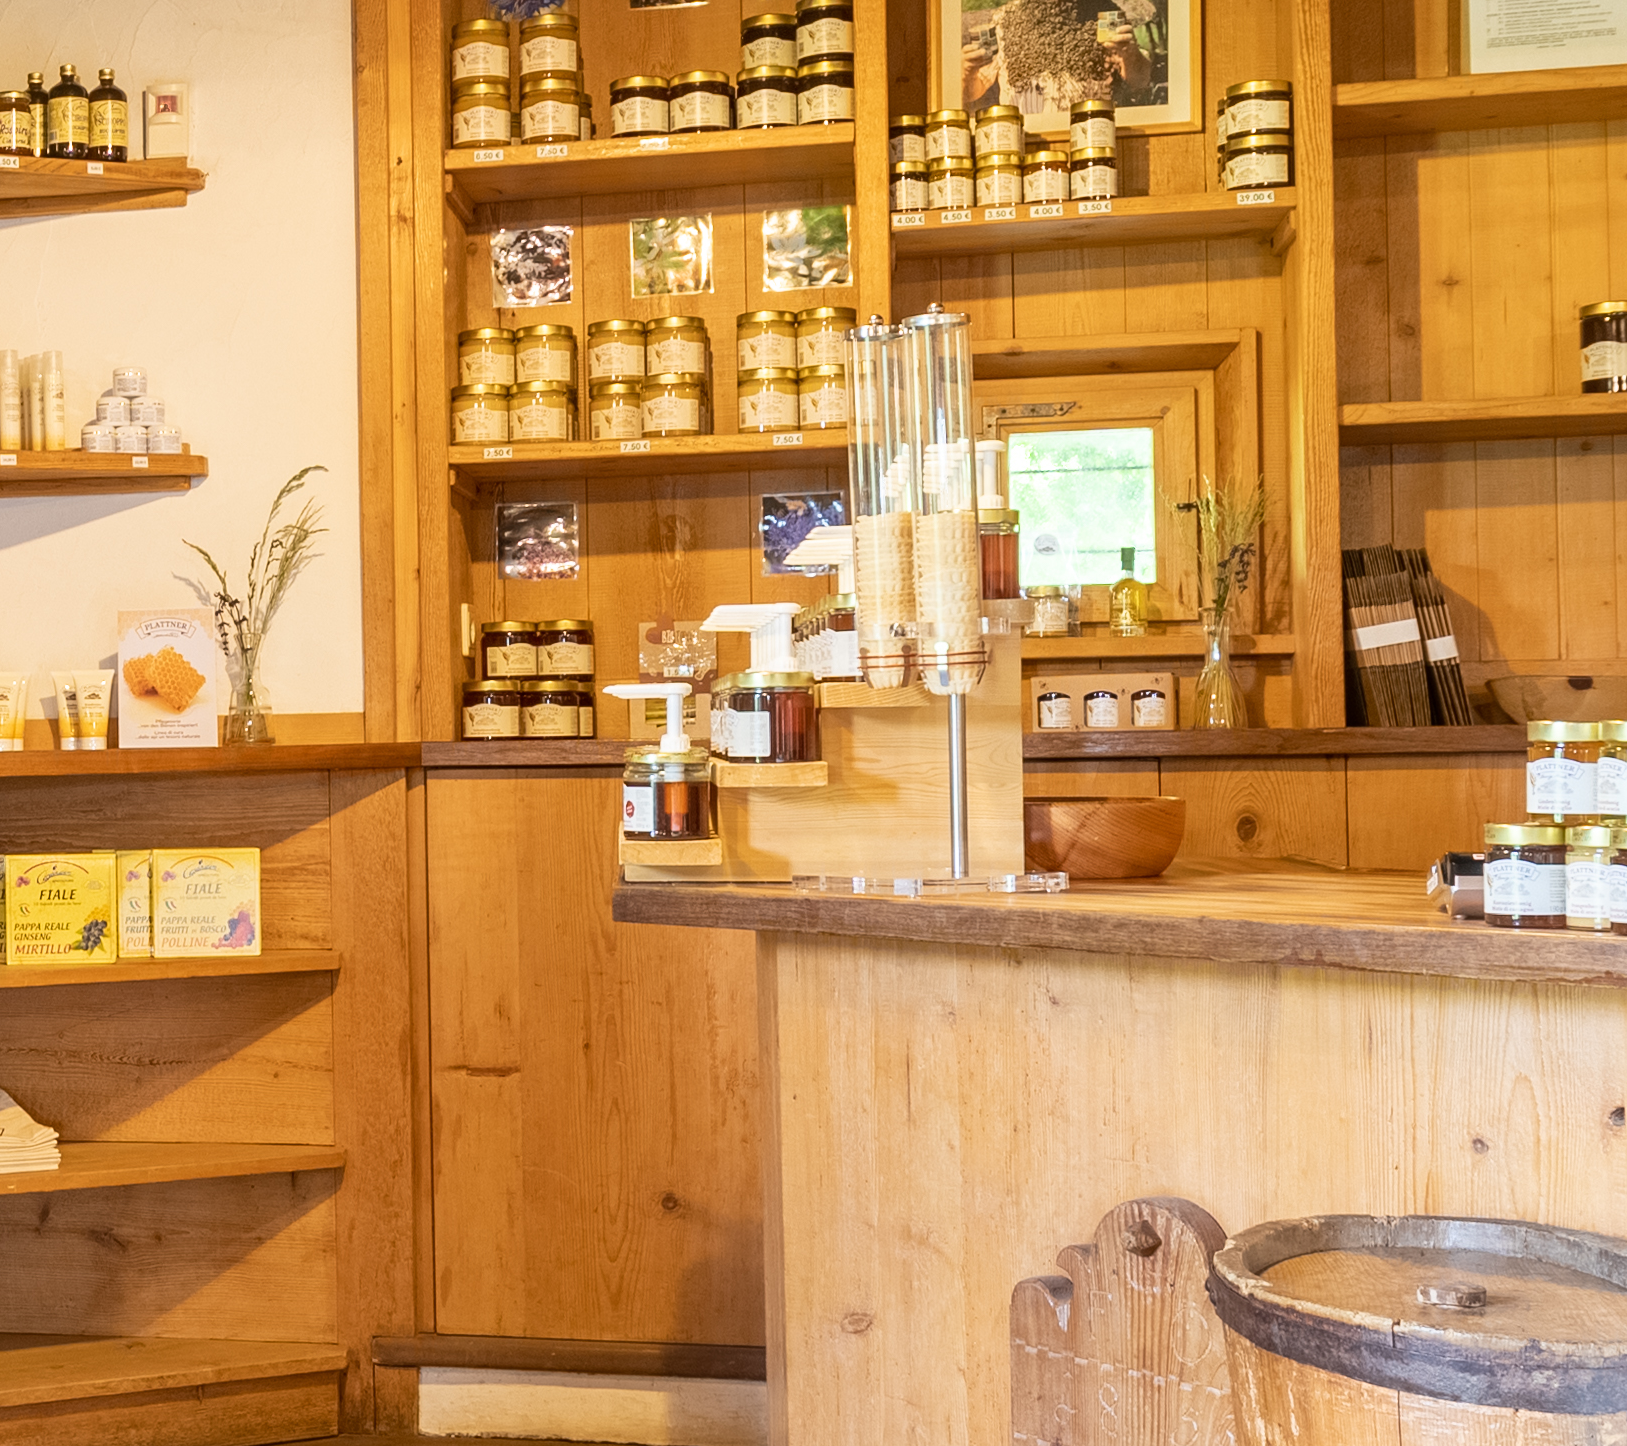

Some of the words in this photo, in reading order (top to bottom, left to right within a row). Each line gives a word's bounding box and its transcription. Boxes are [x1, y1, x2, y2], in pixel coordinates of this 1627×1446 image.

[1239, 193, 1265, 203] 39,00
[1034, 207, 1053, 215] 4,00
[1082, 203, 1102, 212] 3,50
[943, 213, 962, 221] 4,50
[987, 210, 1006, 219] 3,50
[897, 216, 916, 224] 4,00
[775, 435, 794, 444] 7,50
[623, 442, 641, 451] 7,50
[144, 621, 188, 631] PLATTNER
[1536, 764, 1576, 773] PLATTNER
[1493, 865, 1531, 874] PLATTNER
[186, 883, 222, 895] FIALE
[39, 889, 77, 901] FIALE
[125, 915, 152, 924] PAPPA
[161, 916, 188, 925] PAPPA
[190, 915, 215, 924] REALE
[14, 922, 41, 931] PAPPA
[45, 922, 70, 931] REALE
[161, 925, 189, 934] FRUTTI
[199, 925, 226, 934] BOSCO
[14, 932, 51, 941] GINSENG
[161, 936, 210, 948] POLLINE
[15, 944, 72, 955] MIRTILLO
